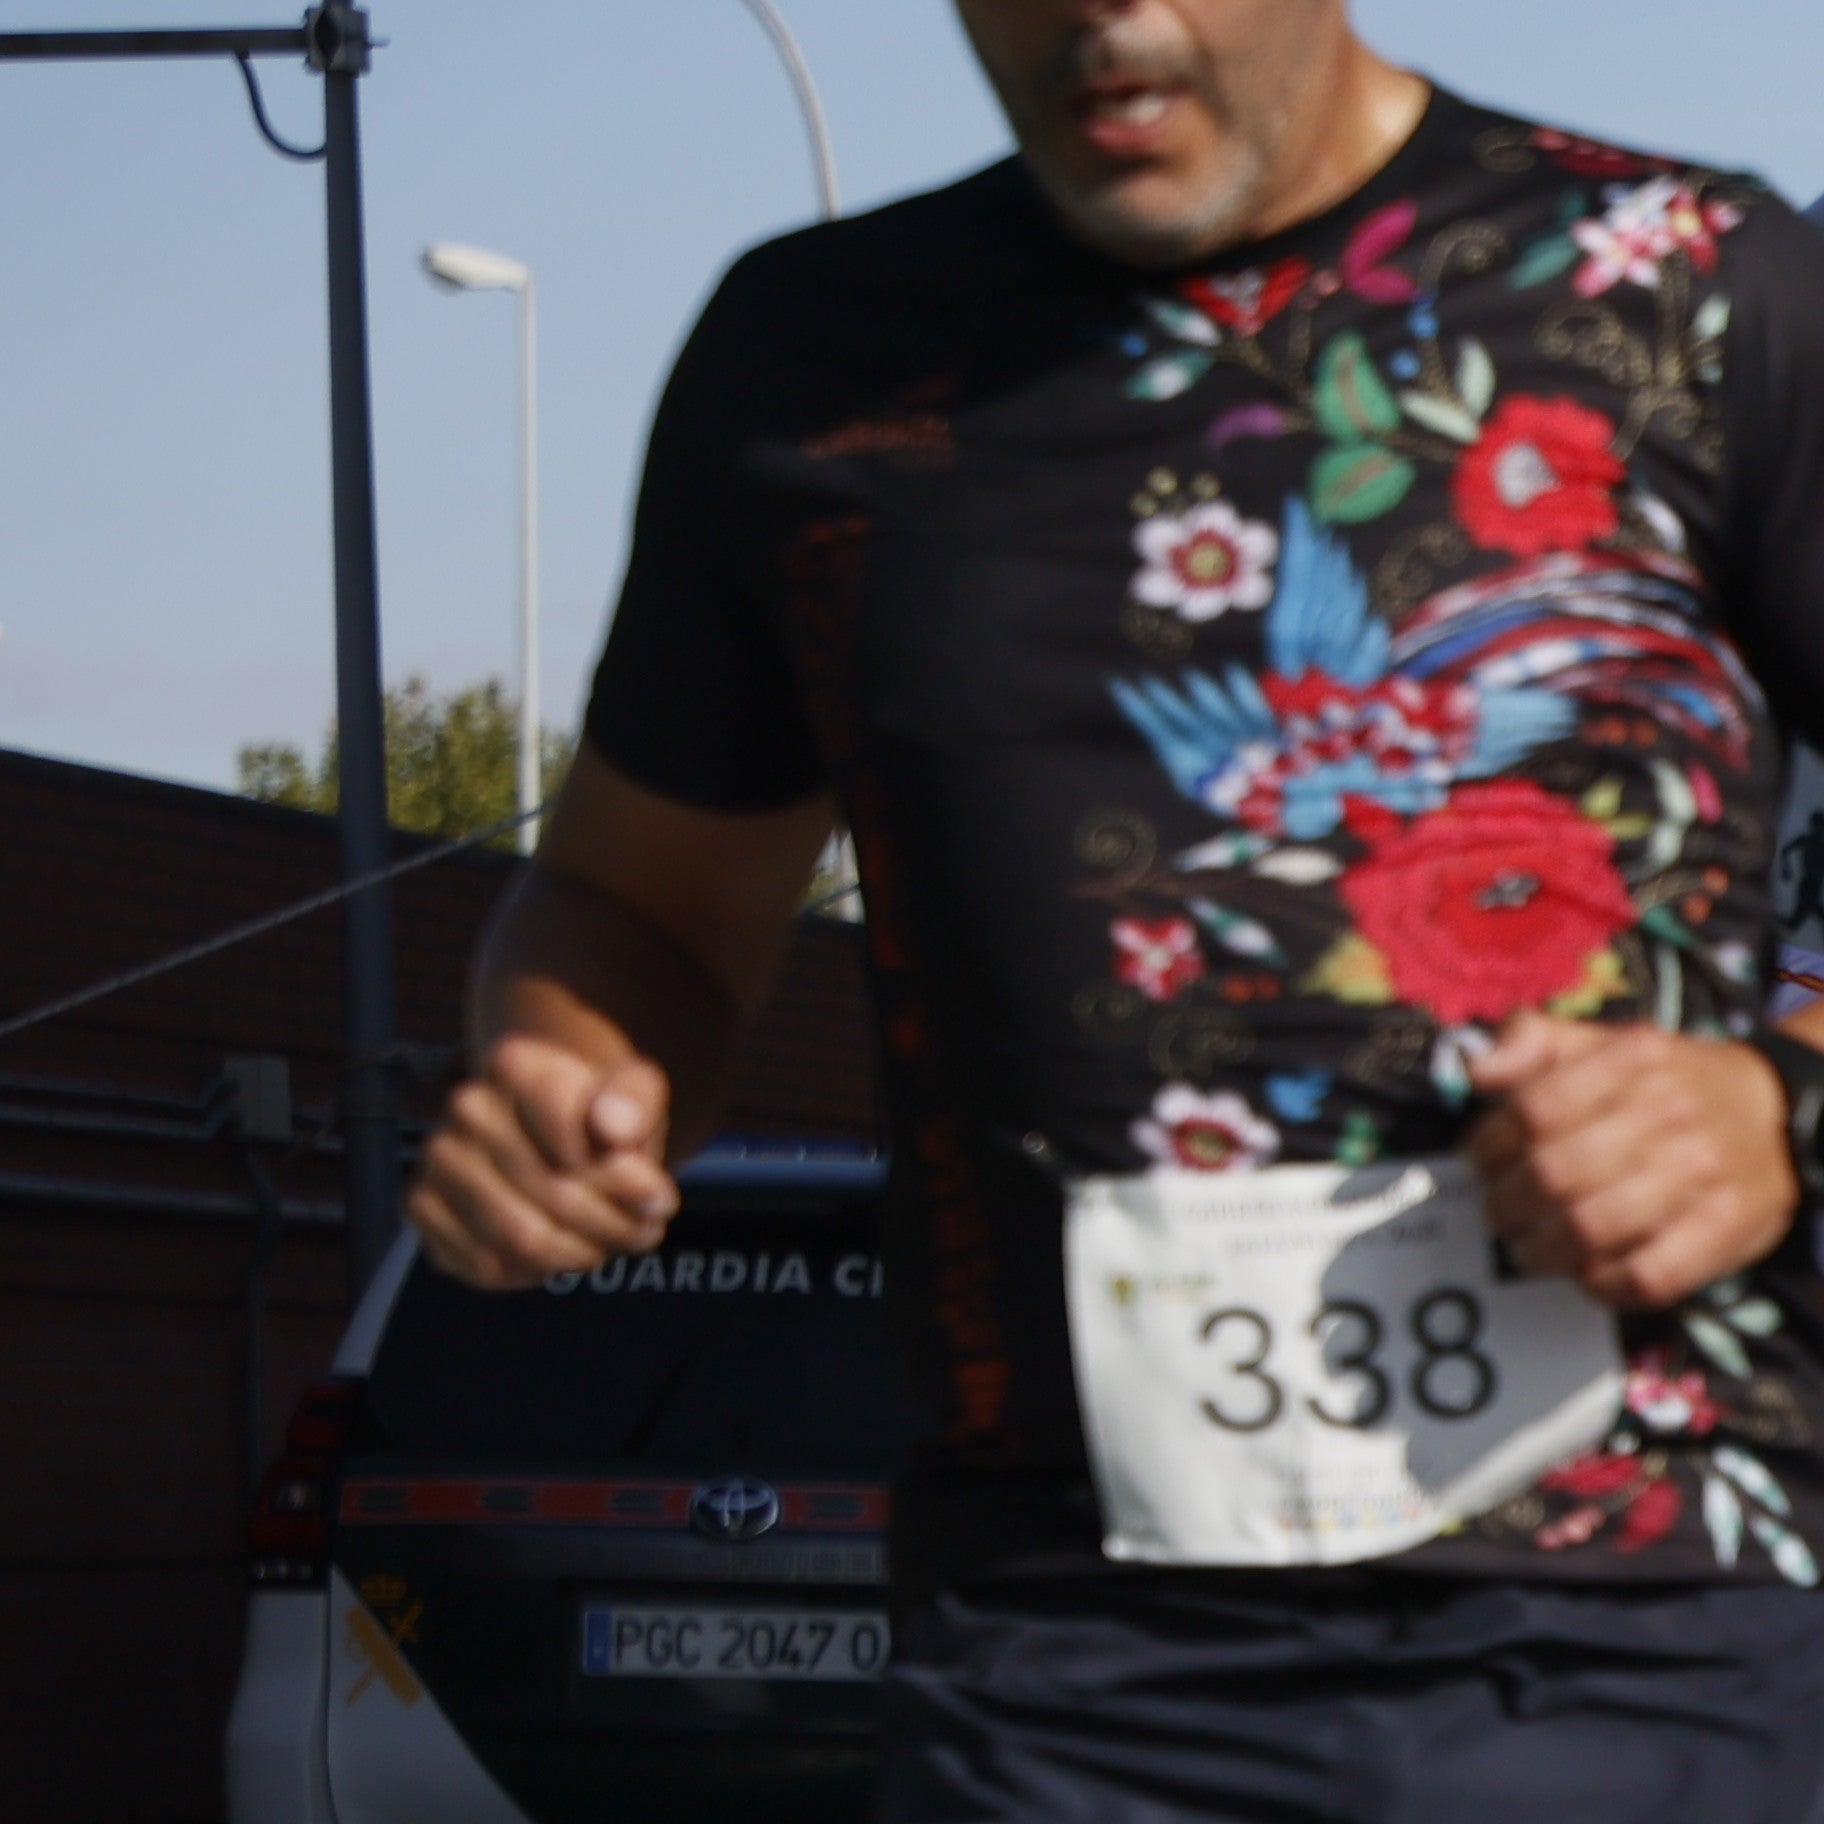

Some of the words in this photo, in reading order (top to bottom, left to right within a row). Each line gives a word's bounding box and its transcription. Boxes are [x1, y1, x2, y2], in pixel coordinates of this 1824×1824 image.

[1199, 1284, 1498, 1432] 338
[614, 1618, 703, 1668] PGC
[716, 1619, 836, 1672] 2047
